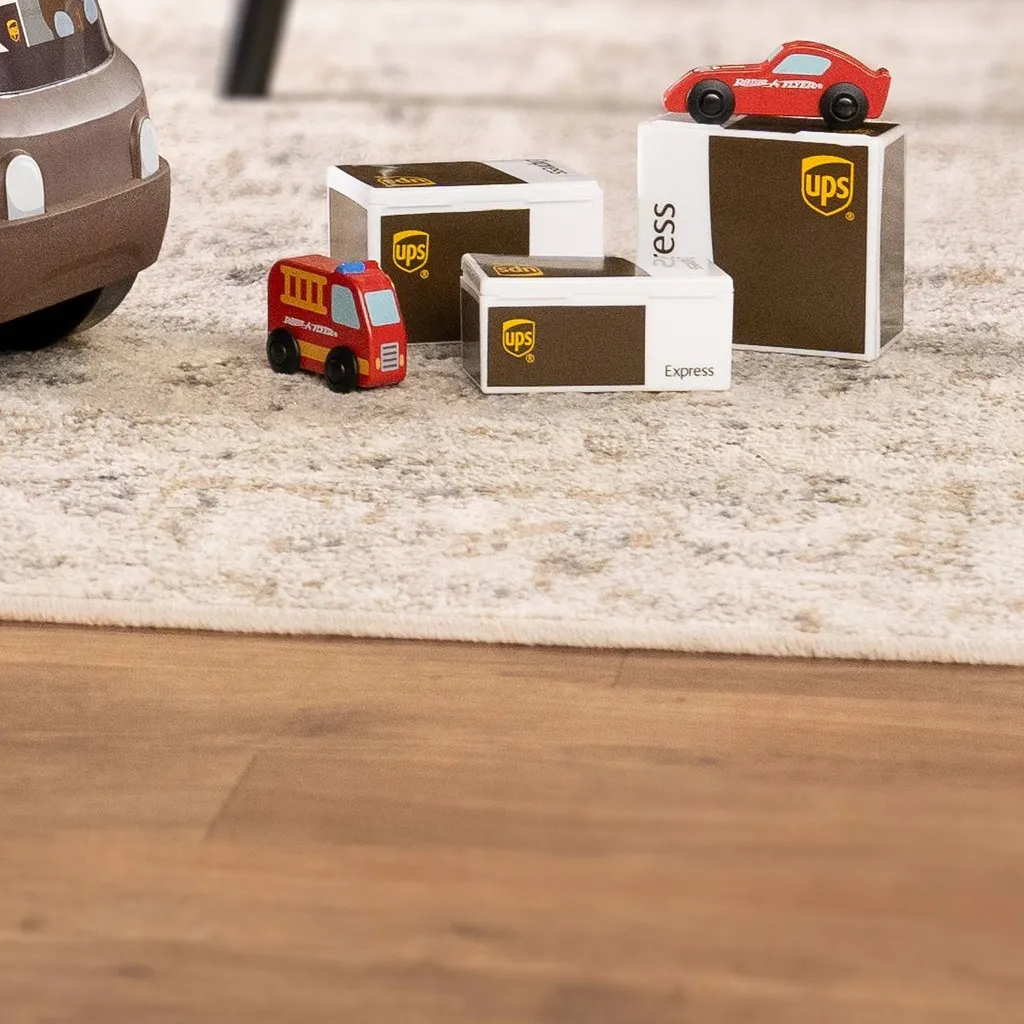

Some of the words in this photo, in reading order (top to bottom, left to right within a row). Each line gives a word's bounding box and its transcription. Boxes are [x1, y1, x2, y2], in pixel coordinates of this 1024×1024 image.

[805, 174, 849, 206] ups
[395, 243, 426, 266] ups
[505, 330, 533, 352] ups
[665, 364, 715, 380] Express
